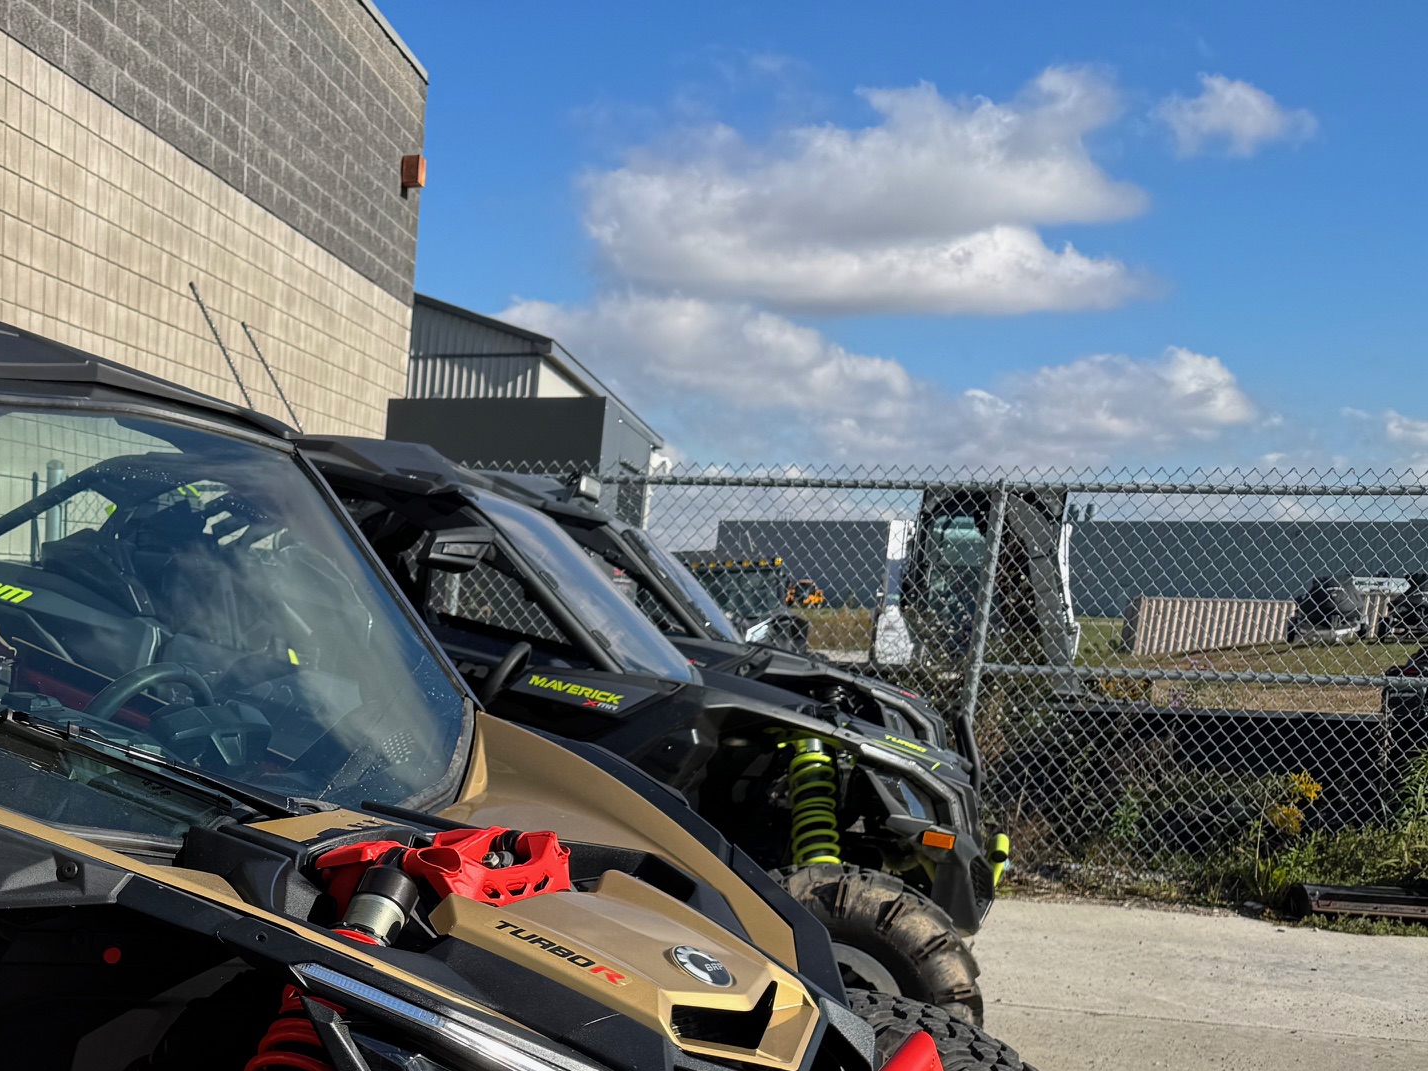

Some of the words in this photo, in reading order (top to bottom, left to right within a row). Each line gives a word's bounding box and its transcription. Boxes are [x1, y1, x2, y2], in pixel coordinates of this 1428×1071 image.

[528, 674, 625, 705] MAVERICK
[493, 919, 596, 968] TURBO
[704, 962, 724, 972] BRP
